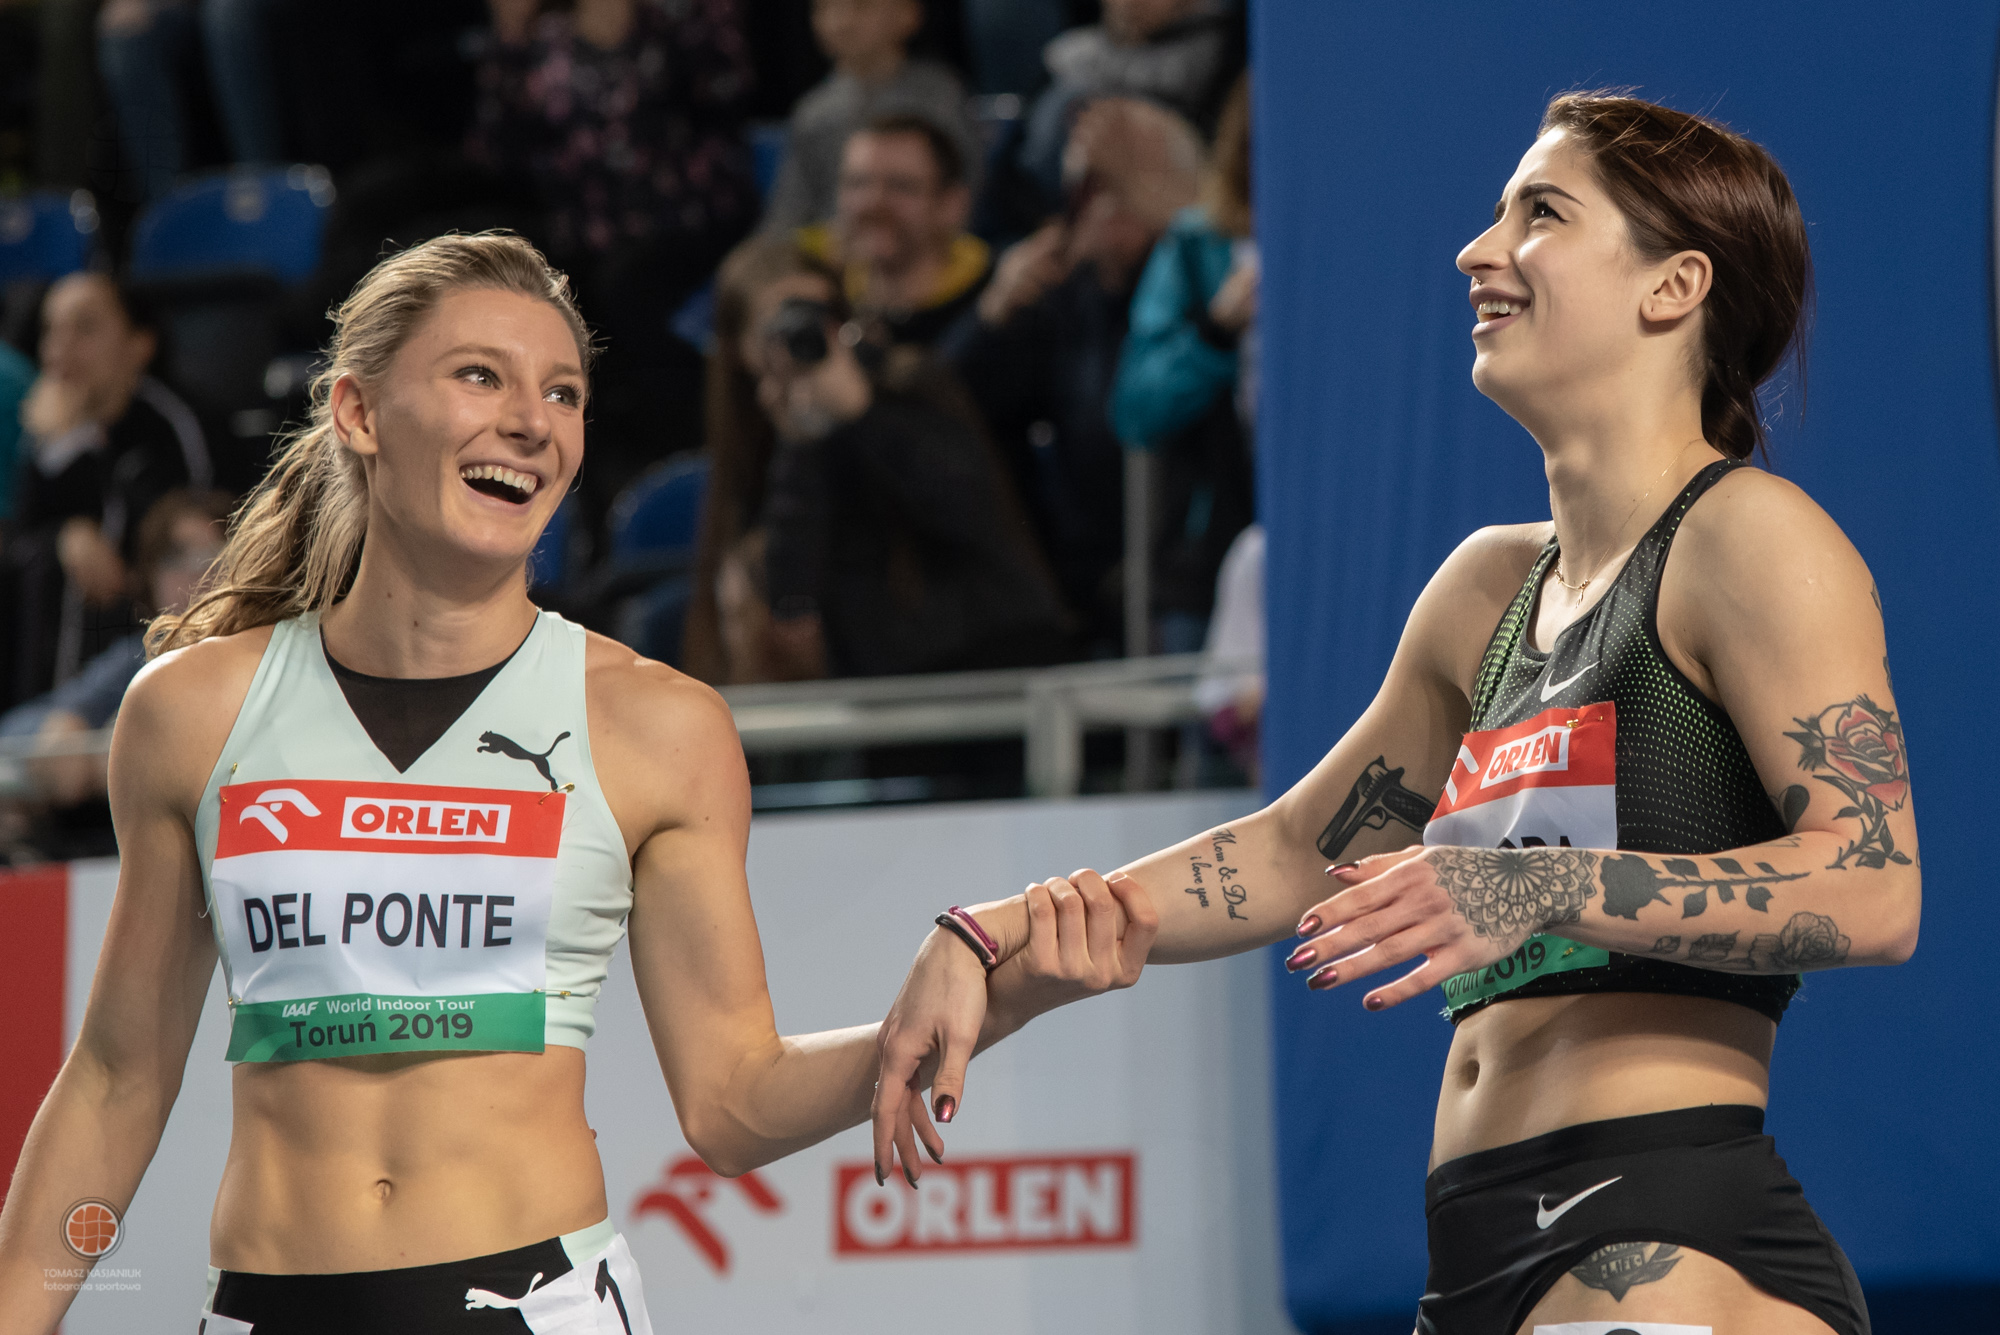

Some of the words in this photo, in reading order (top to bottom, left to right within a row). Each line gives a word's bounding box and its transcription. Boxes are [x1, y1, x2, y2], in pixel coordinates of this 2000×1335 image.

[1488, 732, 1563, 780] ORLEN
[351, 804, 499, 836] ORLEN
[1210, 828, 1237, 862] Mom
[1191, 862, 1212, 884] love
[1218, 866, 1238, 883] &
[1185, 888, 1209, 908] you
[1222, 884, 1248, 920] Dad
[243, 893, 326, 953] DEL
[341, 892, 515, 948] PONTE
[281, 1001, 319, 1018] IAAF
[326, 998, 371, 1014] World
[376, 998, 432, 1011] Indoor
[439, 998, 476, 1011] Tour
[289, 1014, 376, 1048] Toruń
[388, 1013, 473, 1040] 2019
[845, 1163, 1122, 1248] ORLEN
